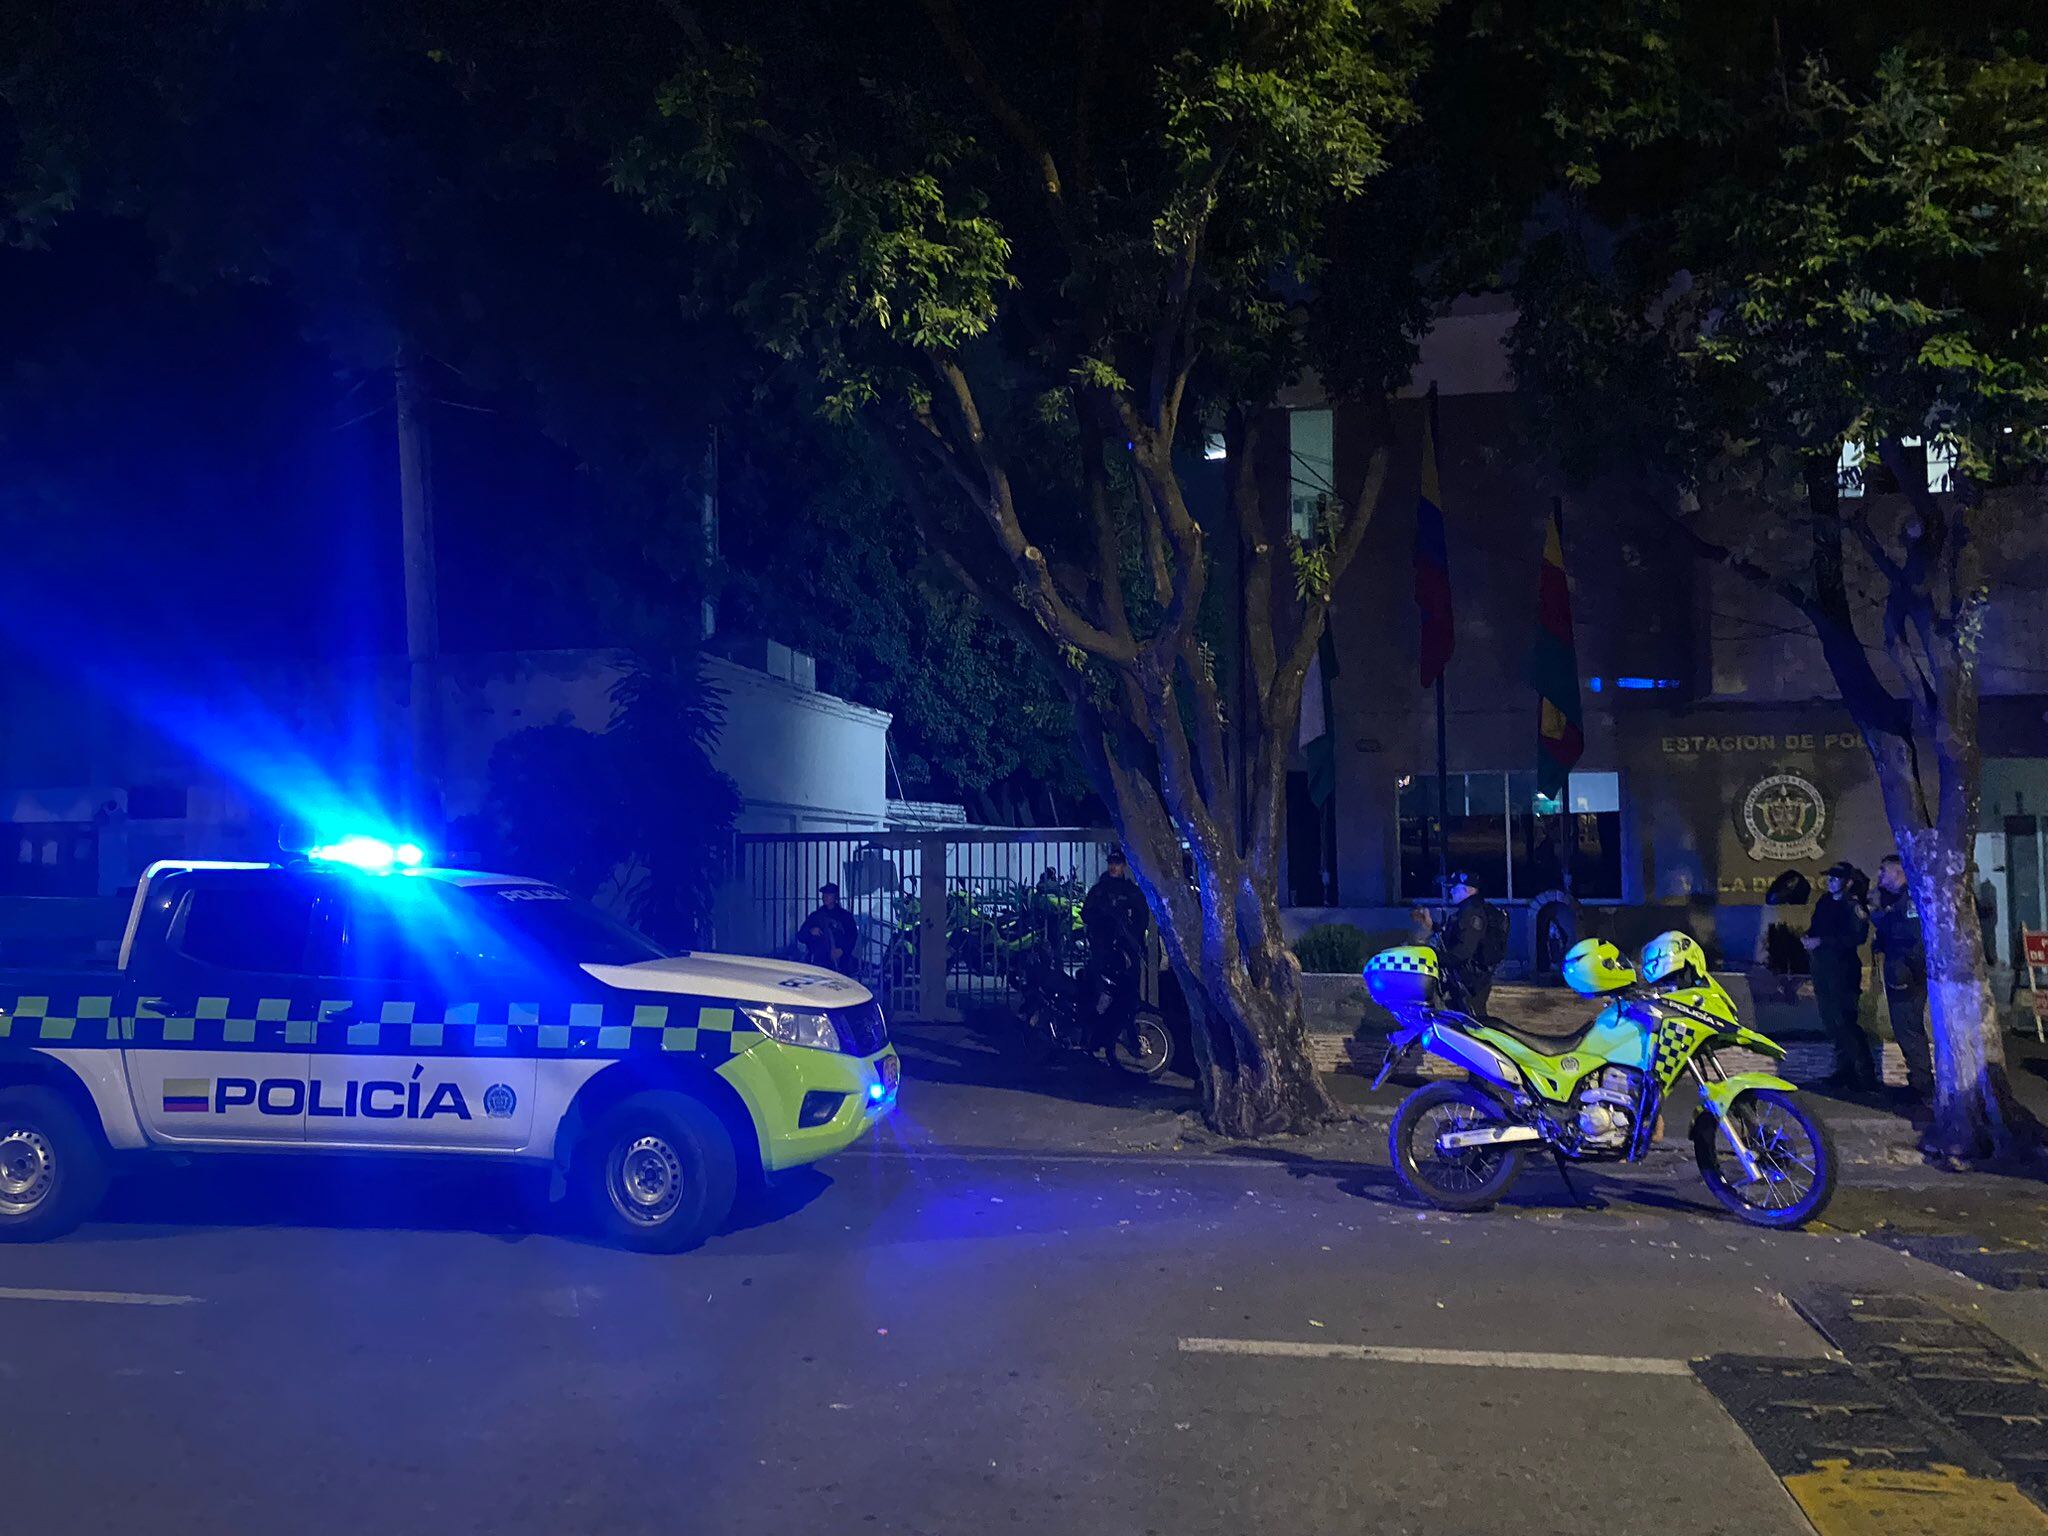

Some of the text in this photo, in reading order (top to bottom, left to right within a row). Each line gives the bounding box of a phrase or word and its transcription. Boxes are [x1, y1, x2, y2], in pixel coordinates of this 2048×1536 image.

[1661, 735, 1776, 752] ESTACION
[1785, 733, 1815, 750] DE
[215, 1063, 472, 1120] POLICÍA
